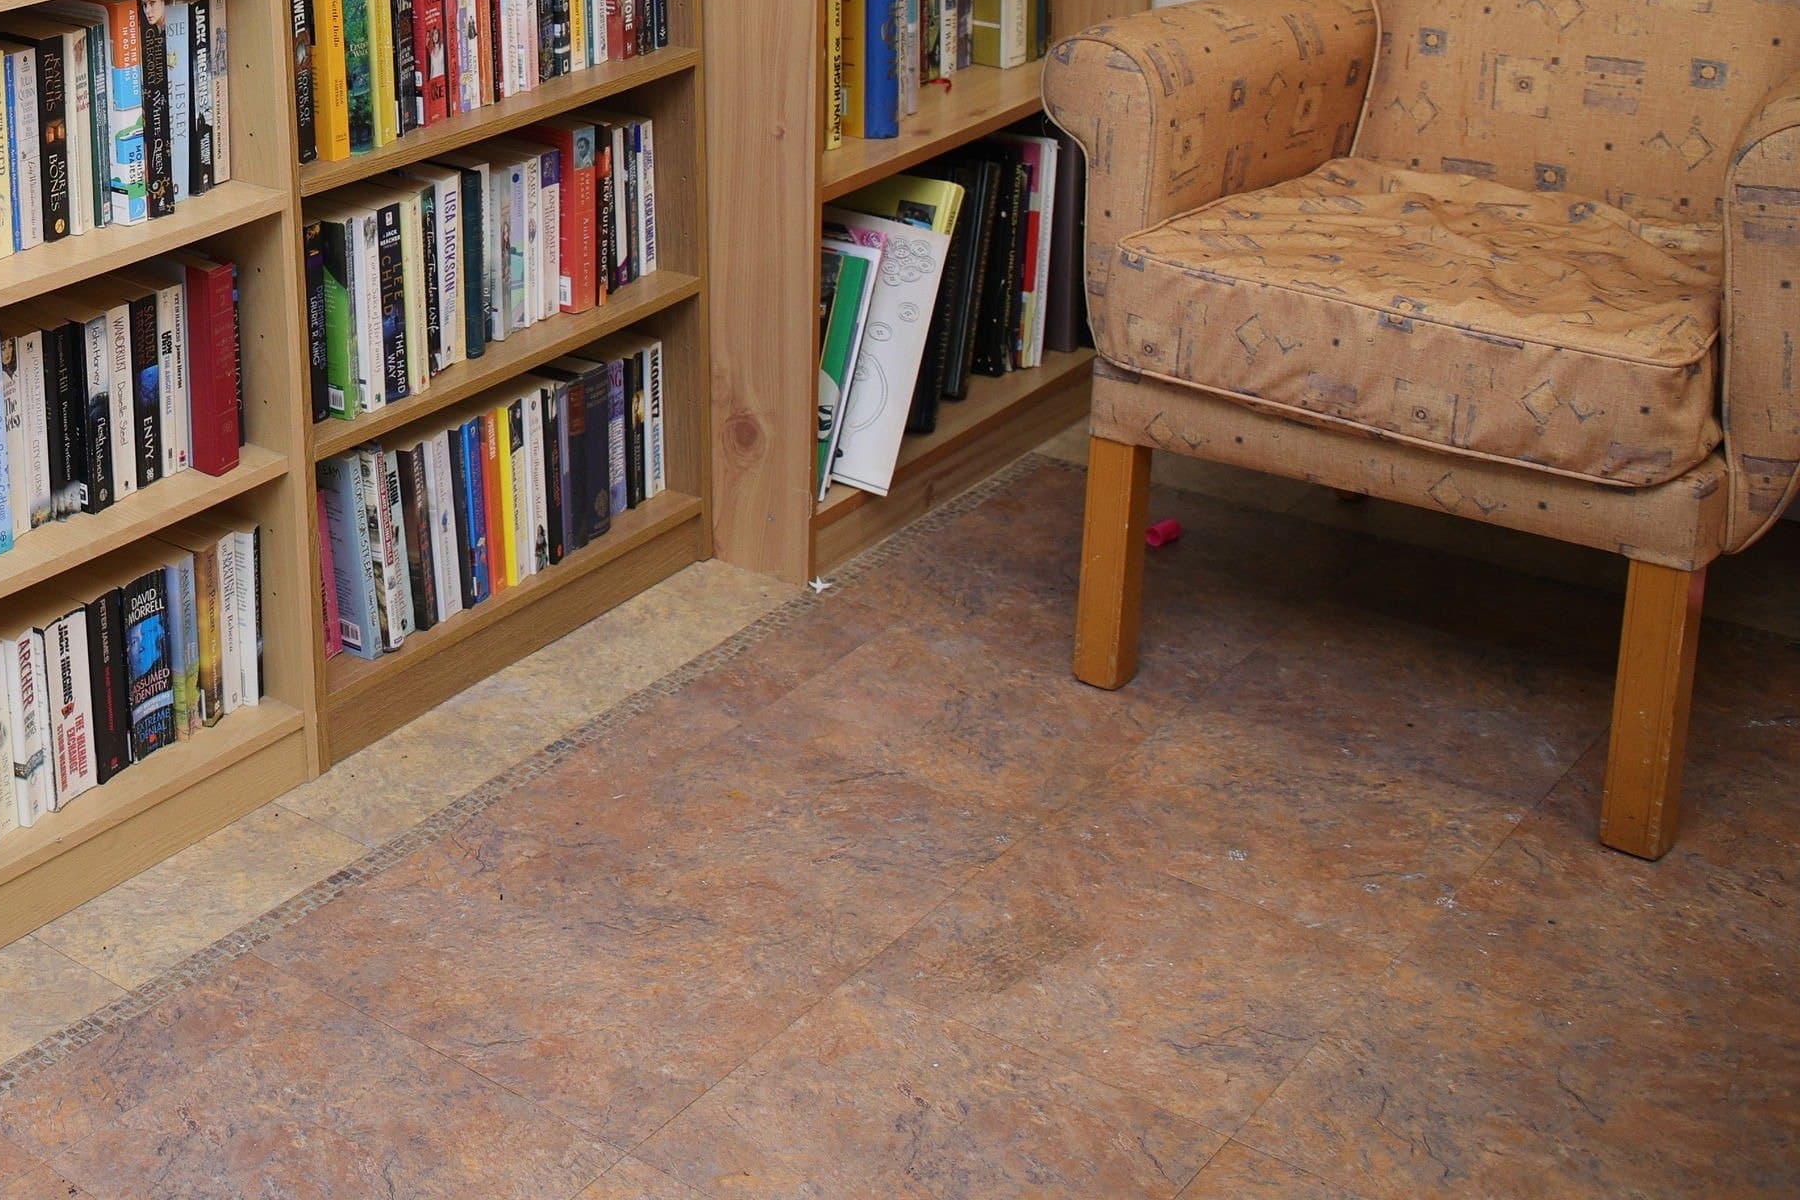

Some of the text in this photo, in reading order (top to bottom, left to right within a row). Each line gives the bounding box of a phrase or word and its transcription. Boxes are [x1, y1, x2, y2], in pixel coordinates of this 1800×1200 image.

[195, 6, 209, 112] JACK HIGGINS
[48, 153, 61, 212] BONES
[444, 191, 457, 293] LISA JACKSON
[382, 256, 394, 315] CHILD
[394, 331, 403, 352] THE
[396, 354, 406, 393] HARD
[143, 415, 154, 459] ENVY
[127, 599, 165, 624] MORRELL
[131, 588, 158, 609] DAVID
[18, 638, 35, 710] ARCHER
[57, 623, 74, 704] JACK HIGGINS
[131, 667, 170, 698] ASSUMED
[132, 680, 168, 704] IDENTITY
[66, 727, 78, 774] EXCHANGE
[74, 712, 88, 778] THE VALHALLA
